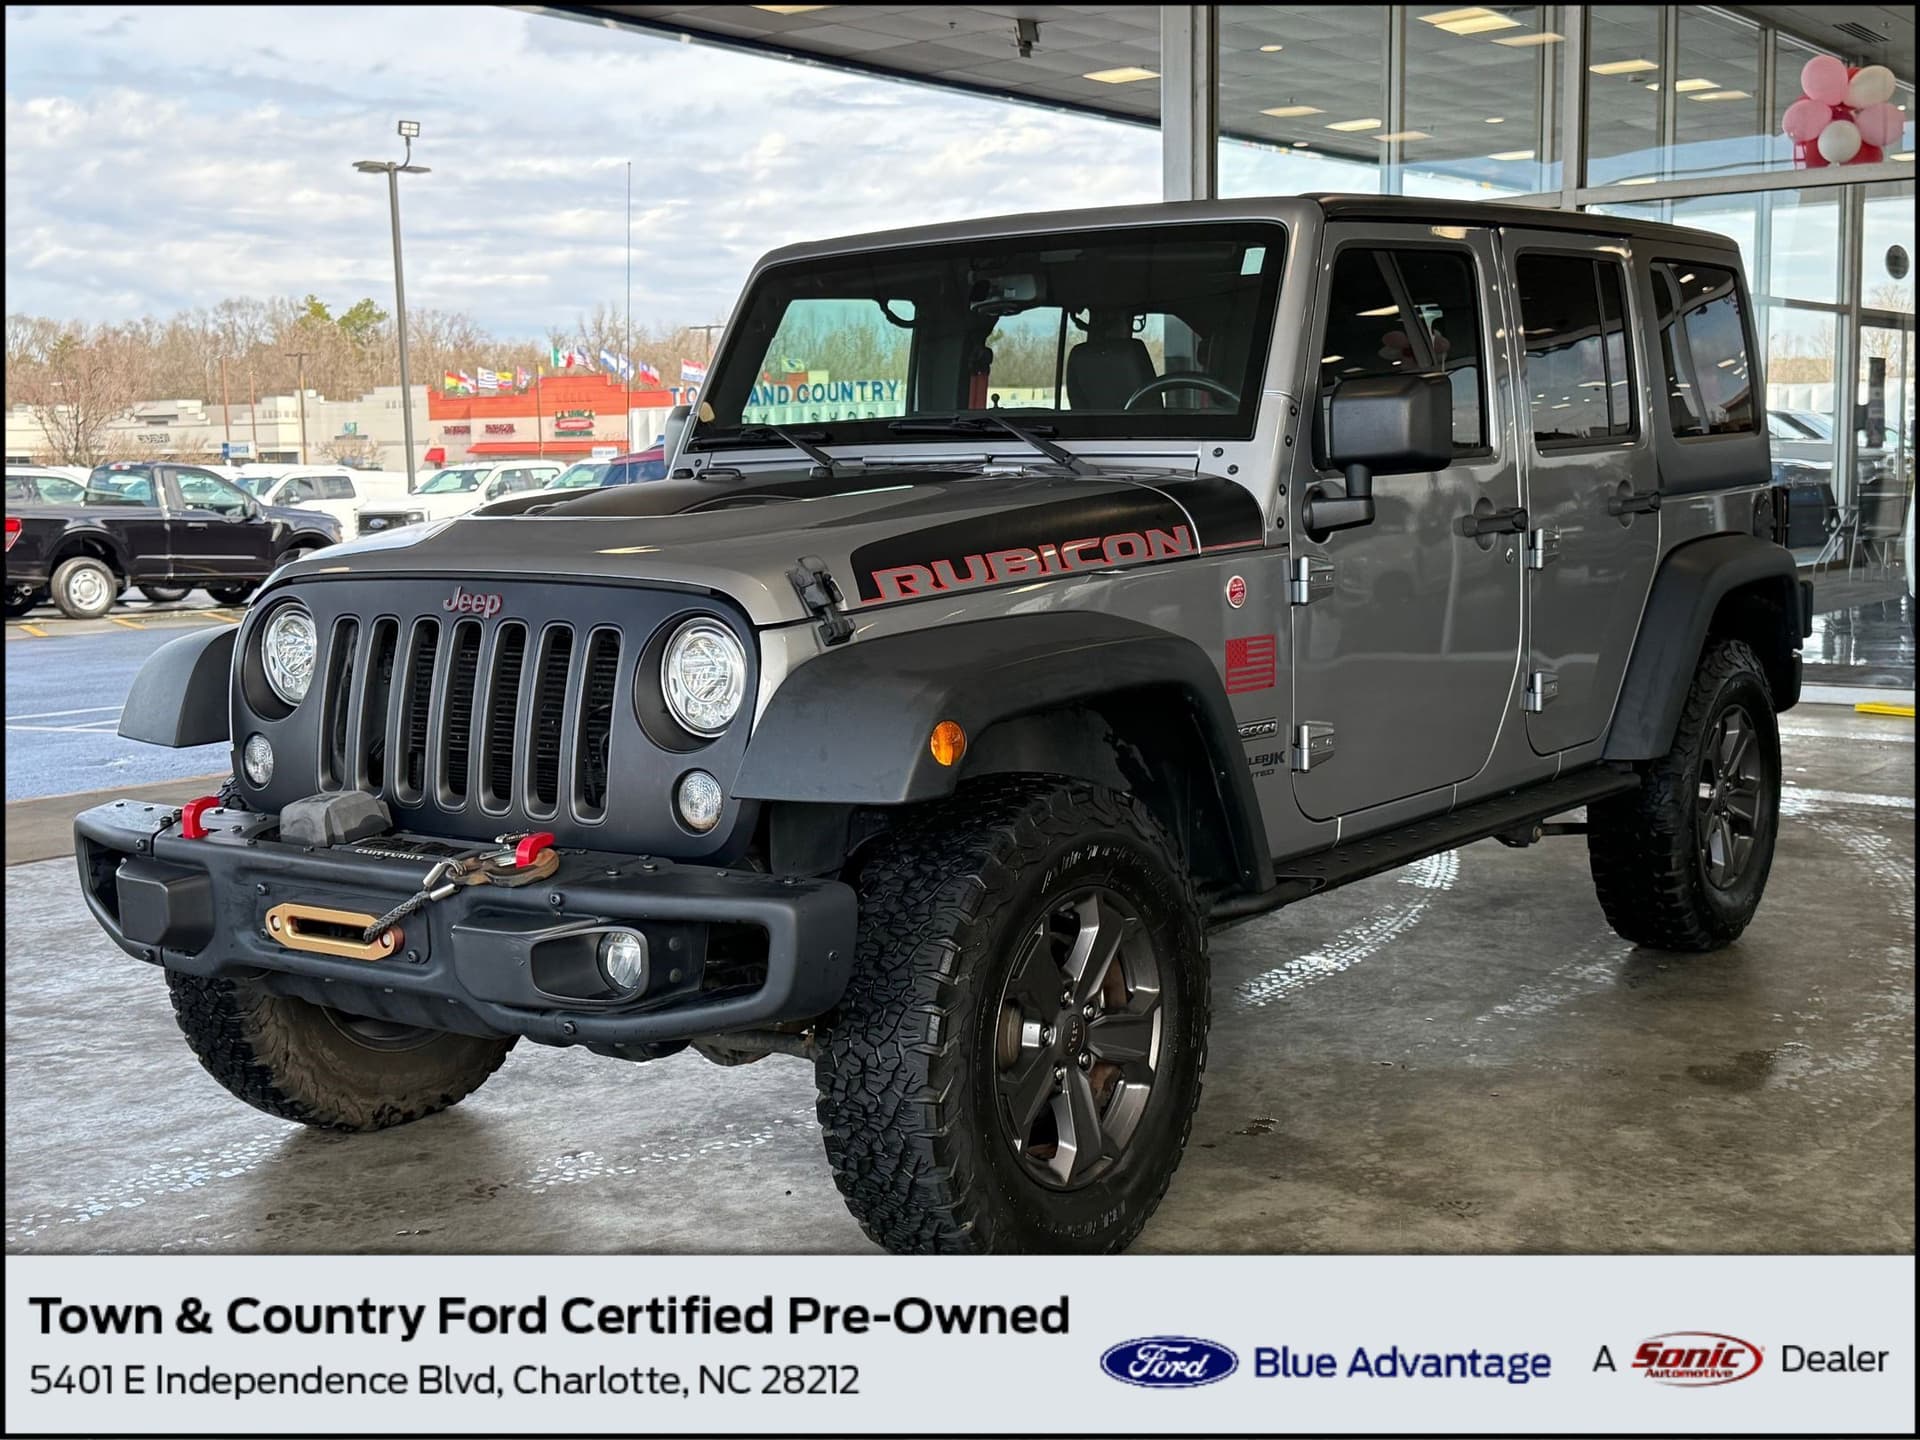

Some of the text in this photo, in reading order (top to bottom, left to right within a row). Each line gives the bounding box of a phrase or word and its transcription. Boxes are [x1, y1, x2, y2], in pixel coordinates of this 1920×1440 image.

[796, 381, 897, 404] COUNTRY
[861, 525, 1194, 604] RUBICON
[443, 585, 503, 619] Jeep
